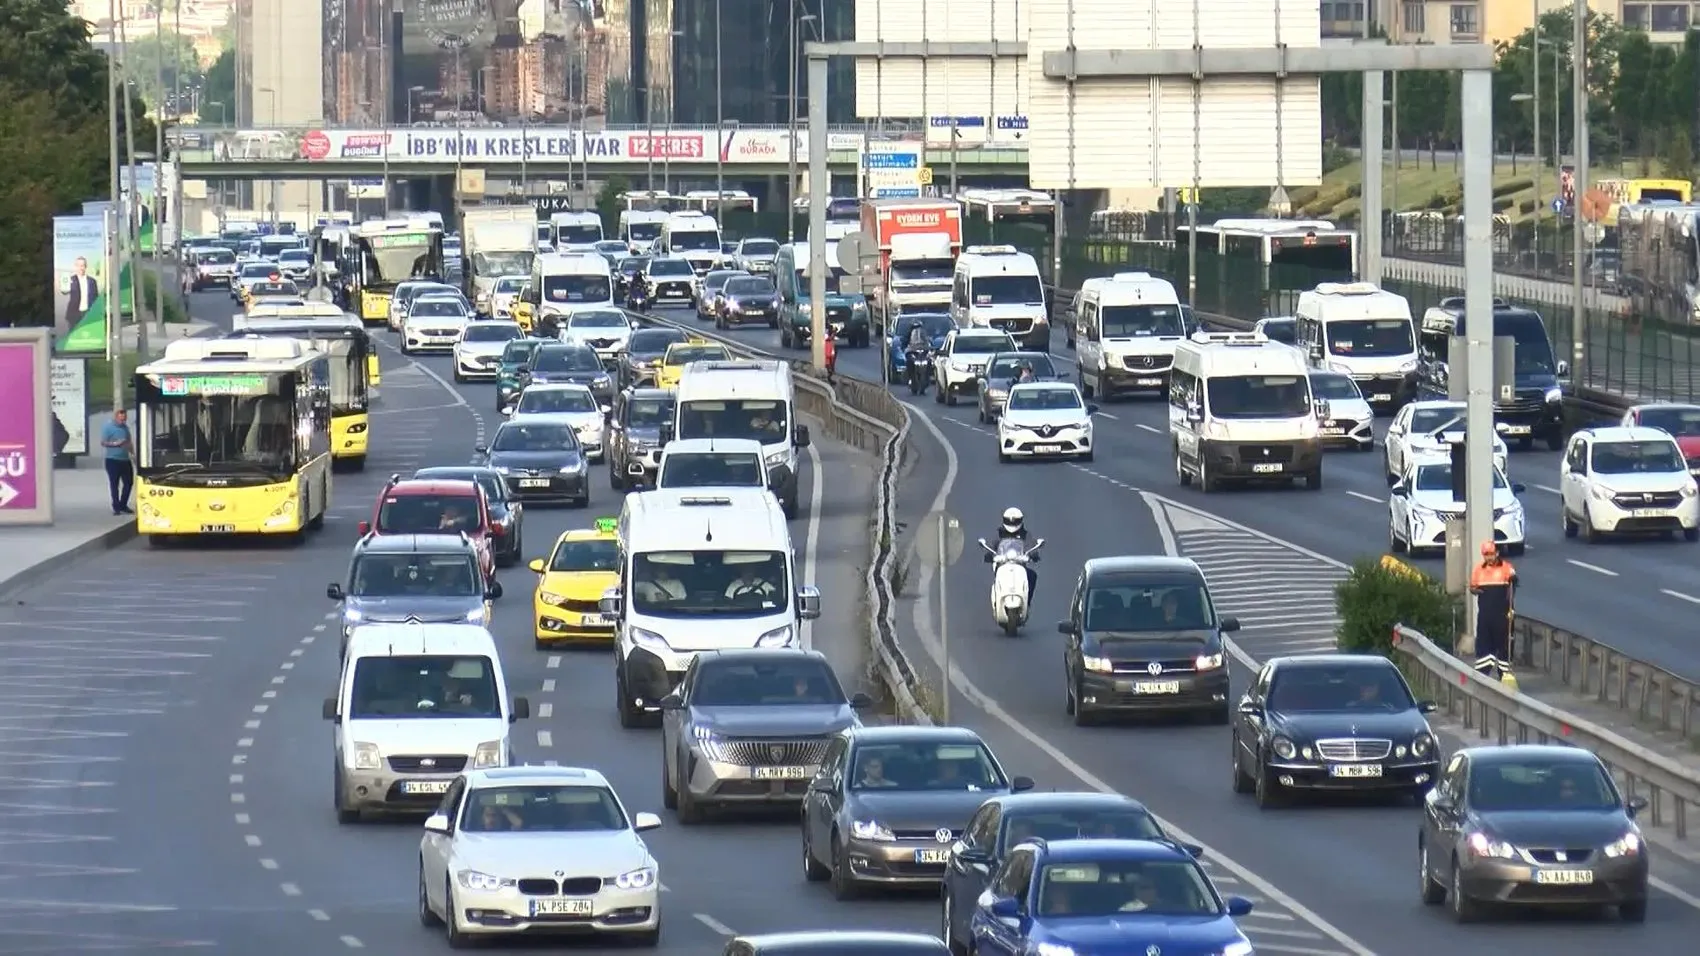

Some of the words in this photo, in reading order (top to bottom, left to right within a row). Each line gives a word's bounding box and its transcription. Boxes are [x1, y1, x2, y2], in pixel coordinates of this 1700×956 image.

[407, 133, 477, 156] İBB'NİN
[485, 133, 576, 159] KREŞLERİ
[584, 138, 620, 156] VAR
[661, 138, 700, 158] KREŞ
[740, 146, 776, 154] BURADA
[537, 901, 547, 912] 34
[552, 901, 568, 911] PSE
